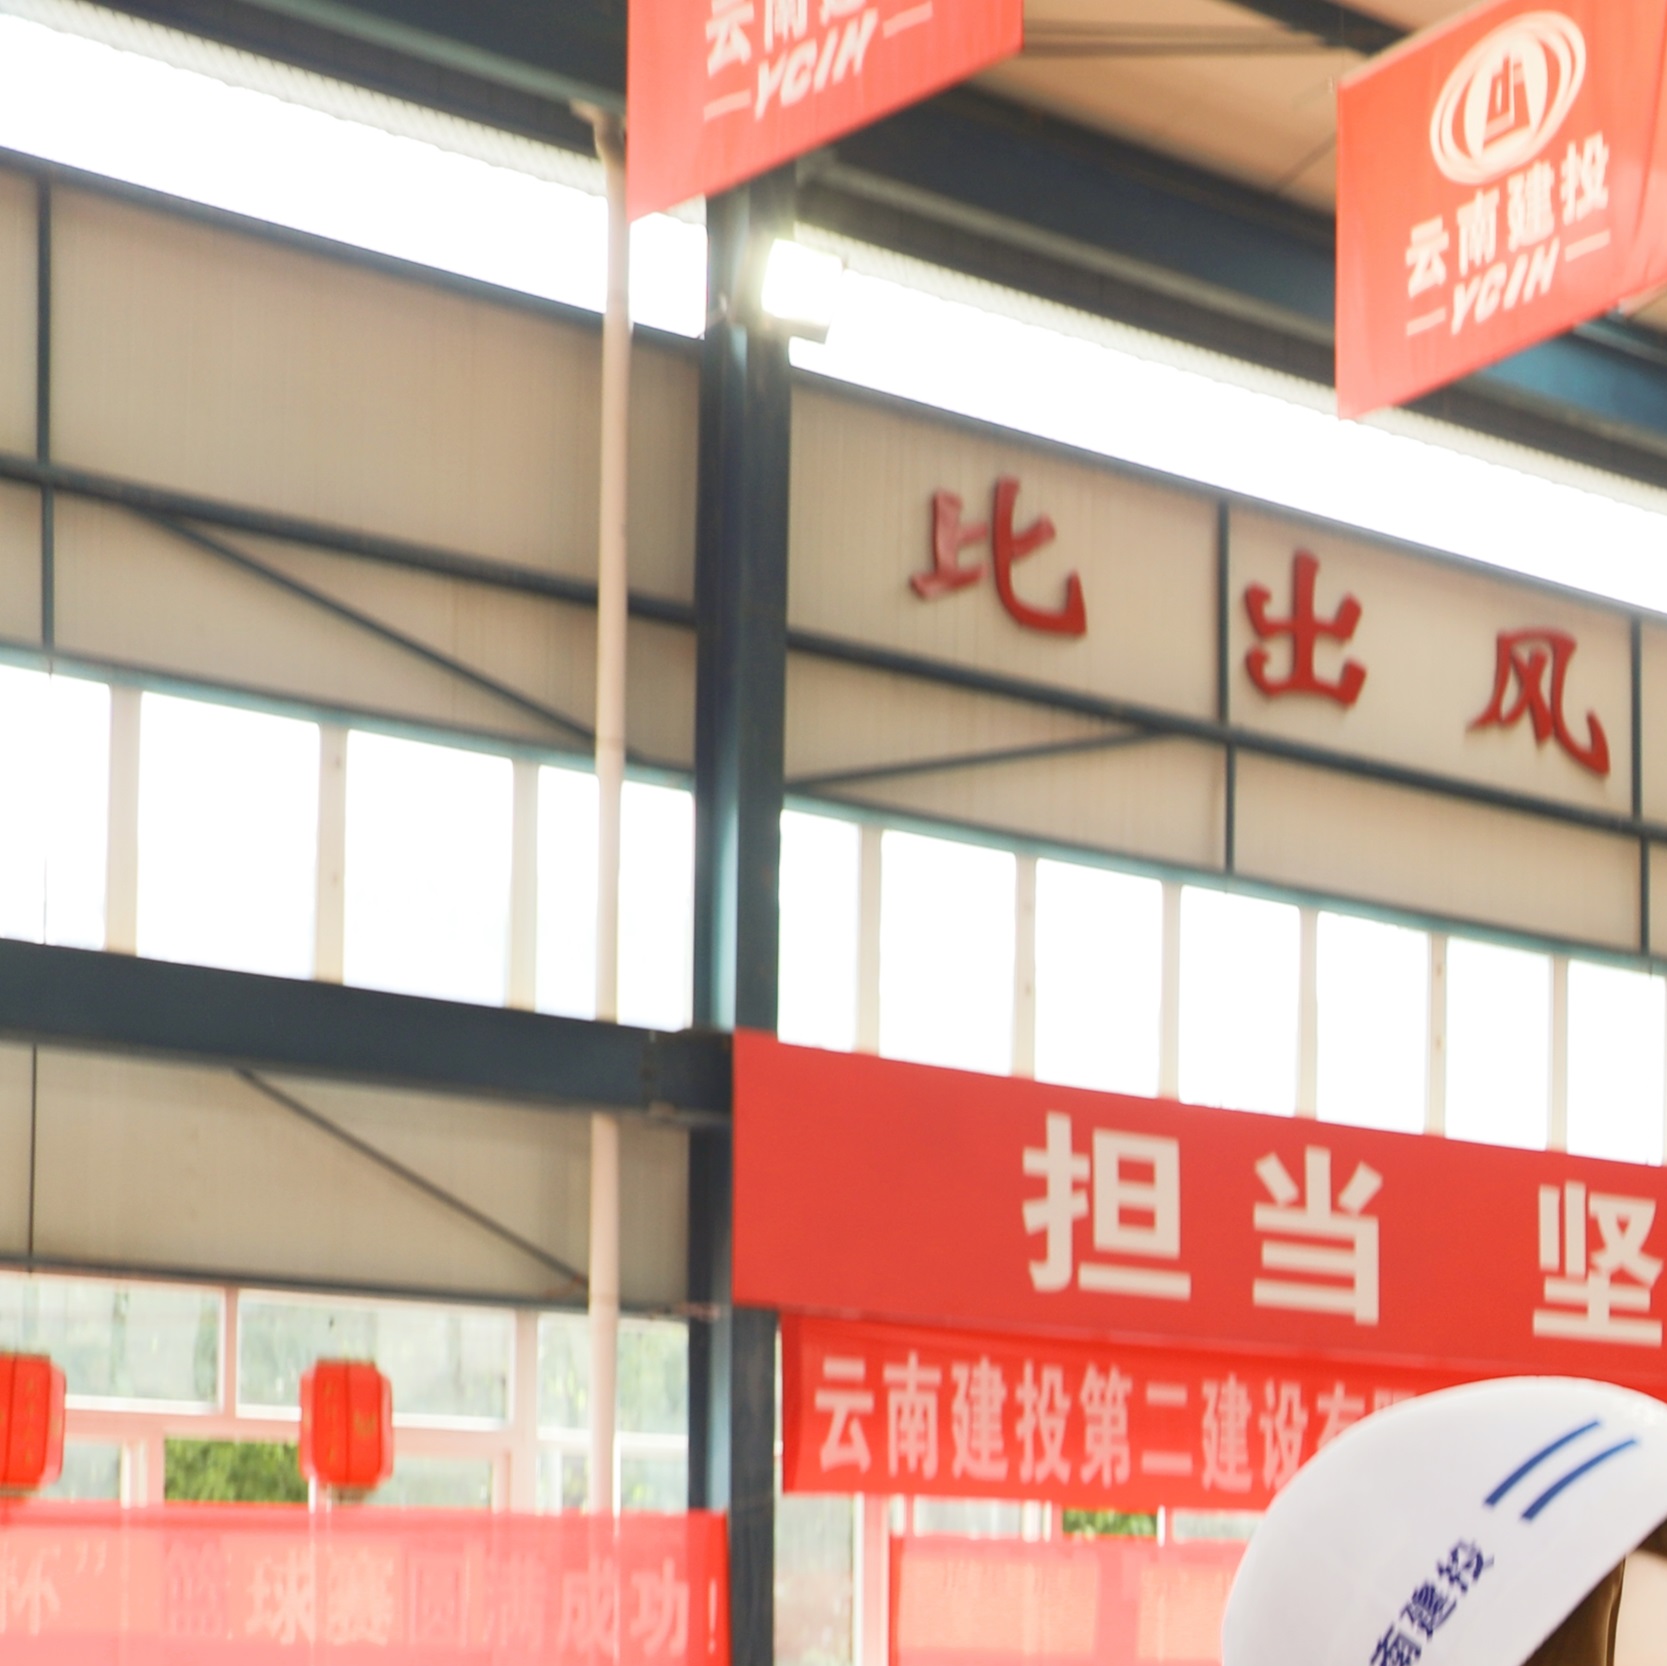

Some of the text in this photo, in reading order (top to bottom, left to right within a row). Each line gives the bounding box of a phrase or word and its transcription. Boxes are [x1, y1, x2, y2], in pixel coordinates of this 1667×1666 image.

[755, 8, 878, 121] YCIH
[1406, 134, 1611, 293] 云南建投
[1448, 234, 1561, 335] YCIH
[1021, 1110, 1380, 1326] 担当
